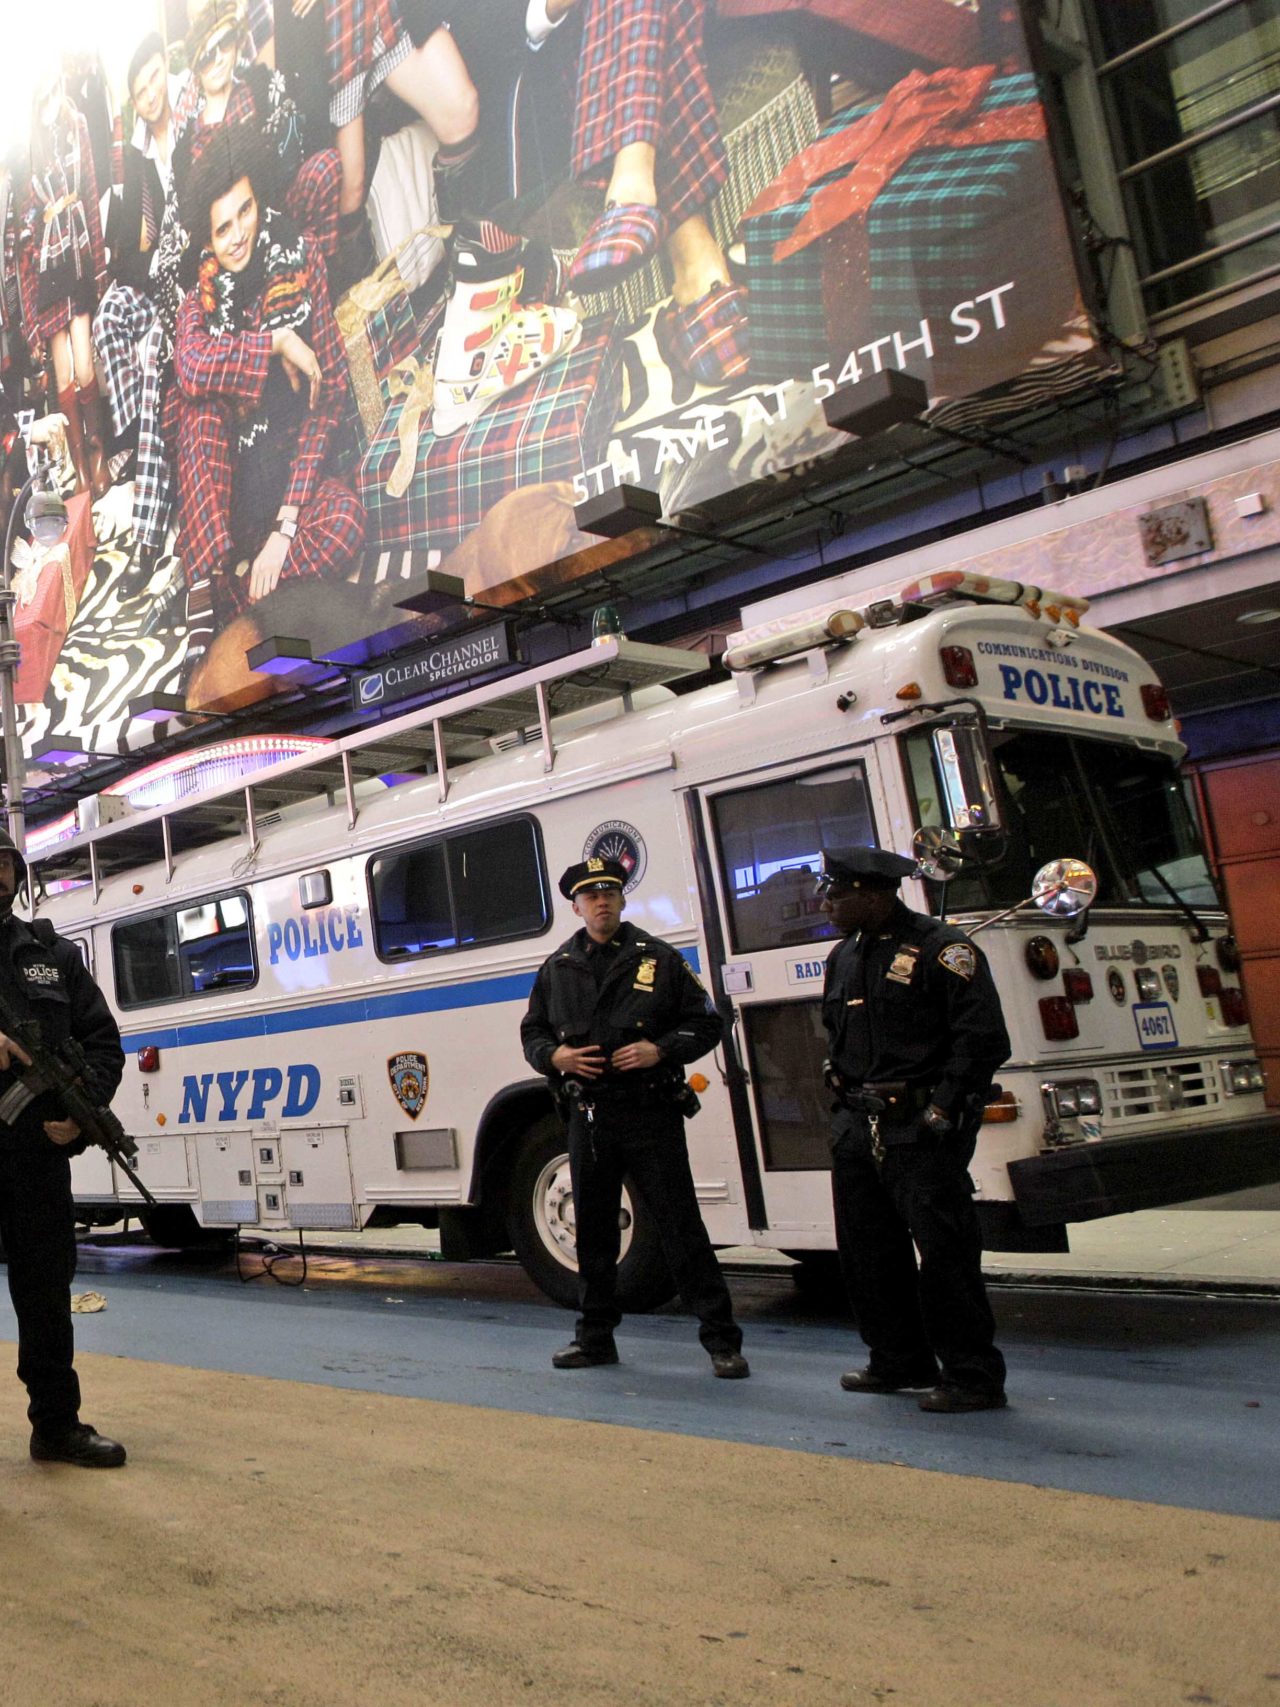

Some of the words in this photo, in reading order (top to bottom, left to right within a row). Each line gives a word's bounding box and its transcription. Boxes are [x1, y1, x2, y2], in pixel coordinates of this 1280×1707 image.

[572, 449, 641, 507] 5TH
[654, 415, 729, 475] AVE
[743, 379, 794, 437] AT
[812, 319, 934, 405] 54TH
[950, 282, 1014, 345] ST
[429, 650, 499, 683] SPECTACOLOR
[977, 641, 1079, 669] COMMUNICATIONS
[1081, 658, 1130, 683] DIVISION
[998, 664, 1126, 718] POLICE
[266, 904, 364, 966] POLICE
[1094, 944, 1133, 961] BLUE
[1146, 944, 1182, 960] BIRD
[23, 967, 60, 978] POLICE
[1141, 1015, 1170, 1037] 4067
[390, 1061, 426, 1077] DEPARTMENT
[395, 1054, 419, 1064] POLICE
[178, 1063, 321, 1124] NYPD
